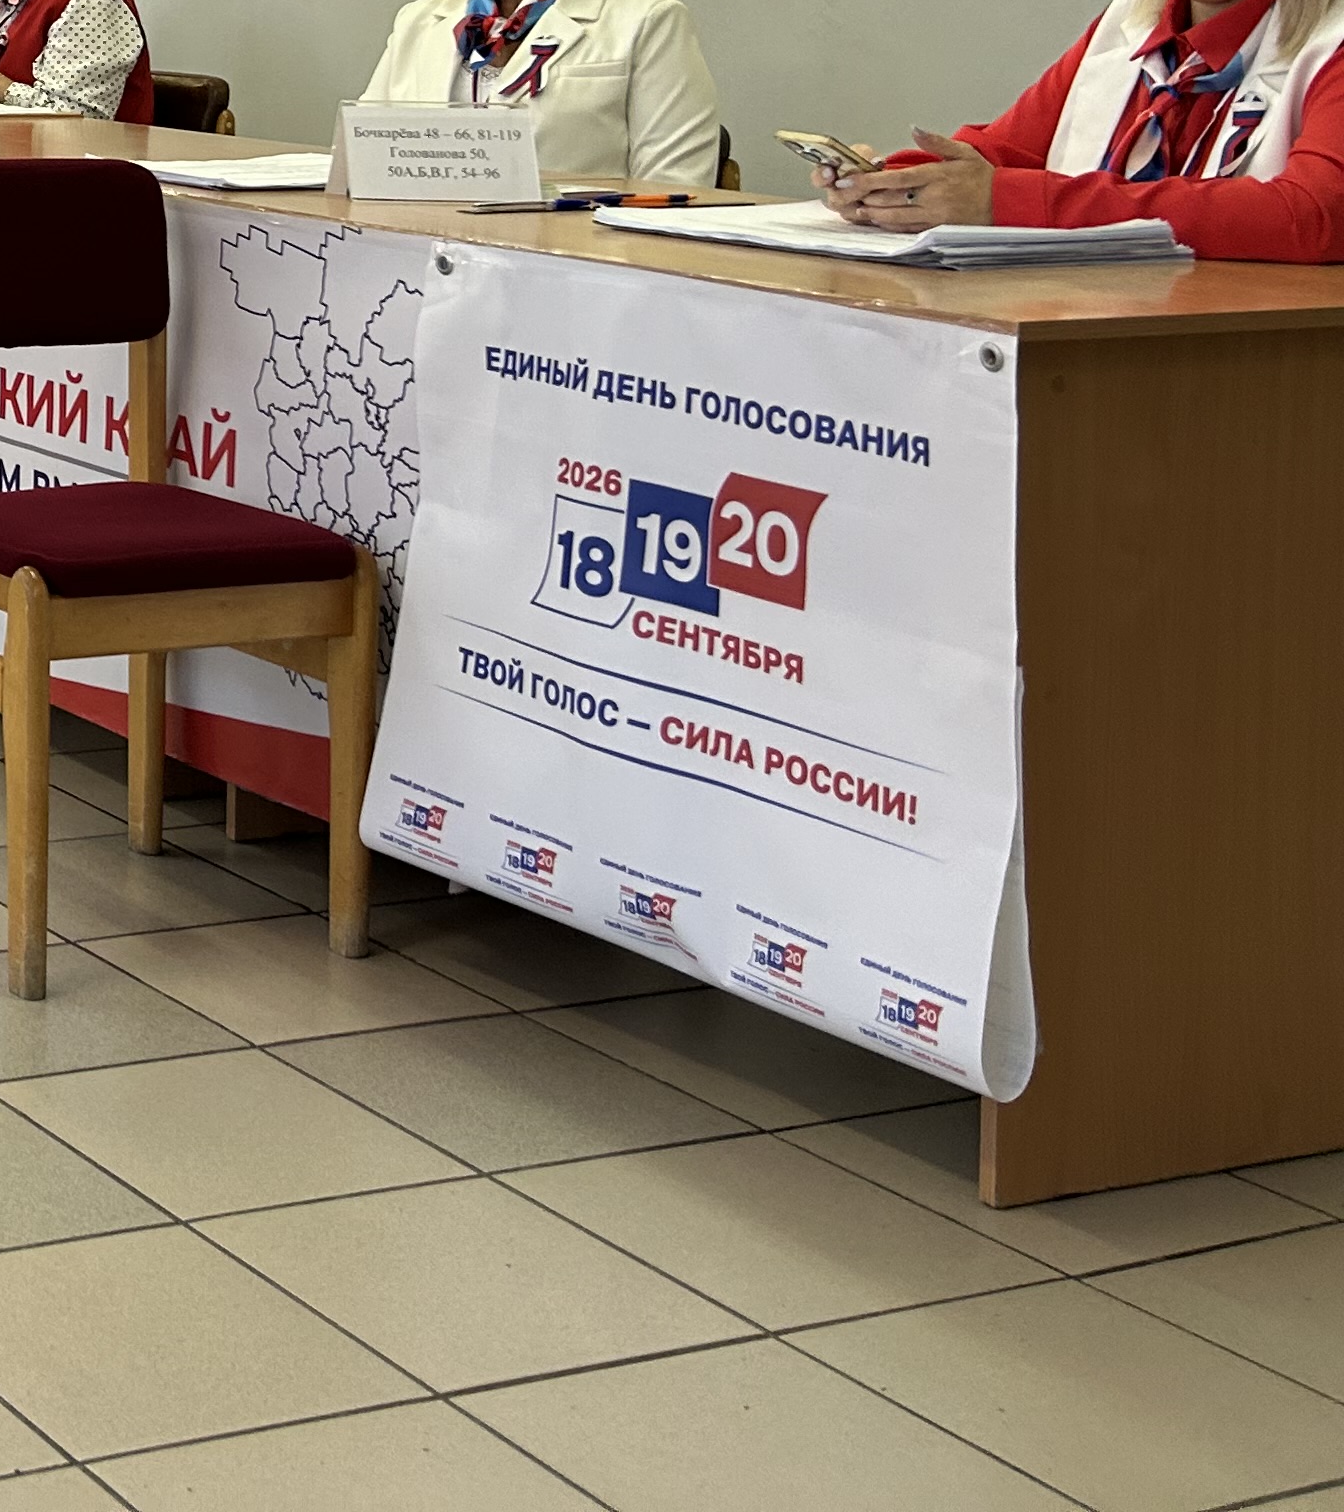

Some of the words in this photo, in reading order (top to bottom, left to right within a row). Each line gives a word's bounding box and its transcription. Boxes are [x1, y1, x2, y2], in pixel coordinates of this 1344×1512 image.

[354, 126, 421, 141] Бочкарёва
[423, 128, 440, 139] 48
[477, 129, 522, 141] 81-119
[390, 146, 466, 159] Голованова
[485, 345, 589, 393] ЕДИНЫЙ
[592, 369, 677, 412] ДЕНЬ
[684, 387, 932, 468] ГОЛОСОВАНИЯ
[104, 399, 237, 488] КАЙ
[557, 456, 623, 497] 2026
[557, 528, 615, 599] 18
[635, 513, 704, 583] 19
[717, 501, 801, 578] 20
[631, 610, 806, 684] СЕНТЯБРЯ
[458, 646, 524, 695] ТВОЙ
[530, 674, 620, 729] ГОЛОС
[659, 714, 755, 769] СИЛА
[764, 745, 919, 826] РОССИИ!
[416, 811, 427, 824] 19
[428, 810, 443, 824] 20
[522, 853, 535, 867] 19
[538, 852, 552, 868] 20
[637, 899, 650, 914] 19
[653, 899, 670, 915] 20
[769, 948, 782, 965] 19
[785, 949, 801, 966] 20
[901, 1004, 915, 1021] 19
[918, 1006, 937, 1024] 20
